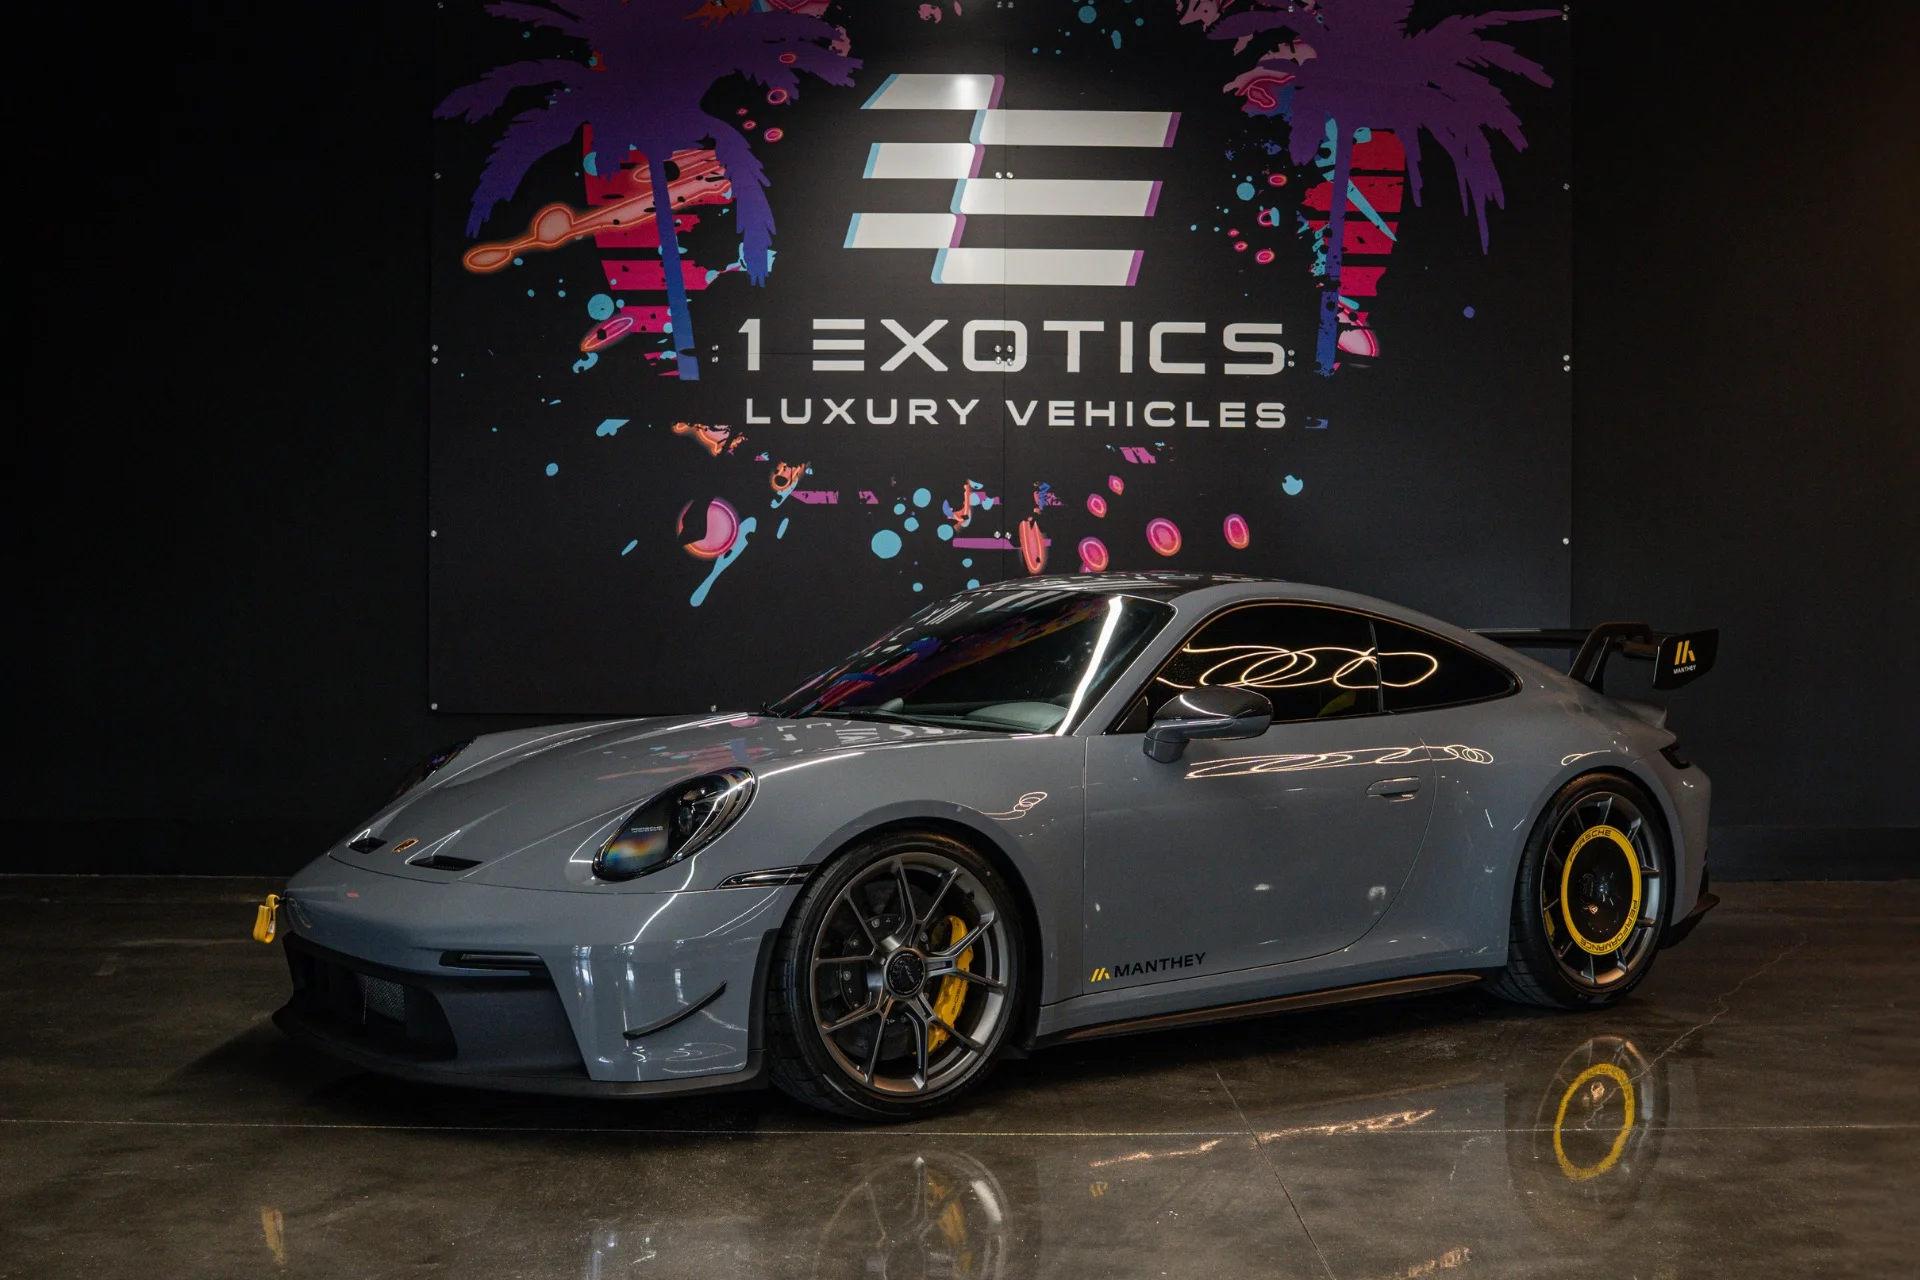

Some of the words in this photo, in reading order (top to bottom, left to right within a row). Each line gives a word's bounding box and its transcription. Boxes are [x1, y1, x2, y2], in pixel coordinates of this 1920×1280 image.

[738, 318, 761, 371] 1
[812, 318, 1286, 375] EXOTICS
[746, 398, 980, 425] LUXURY
[1004, 399, 1286, 429] VEHICLES
[1673, 664, 1697, 674] MANTHEY
[1569, 829, 1612, 862] PORSCHE
[1580, 899, 1638, 952] PERFORMANCE
[1114, 952, 1206, 978] MANTHEY
